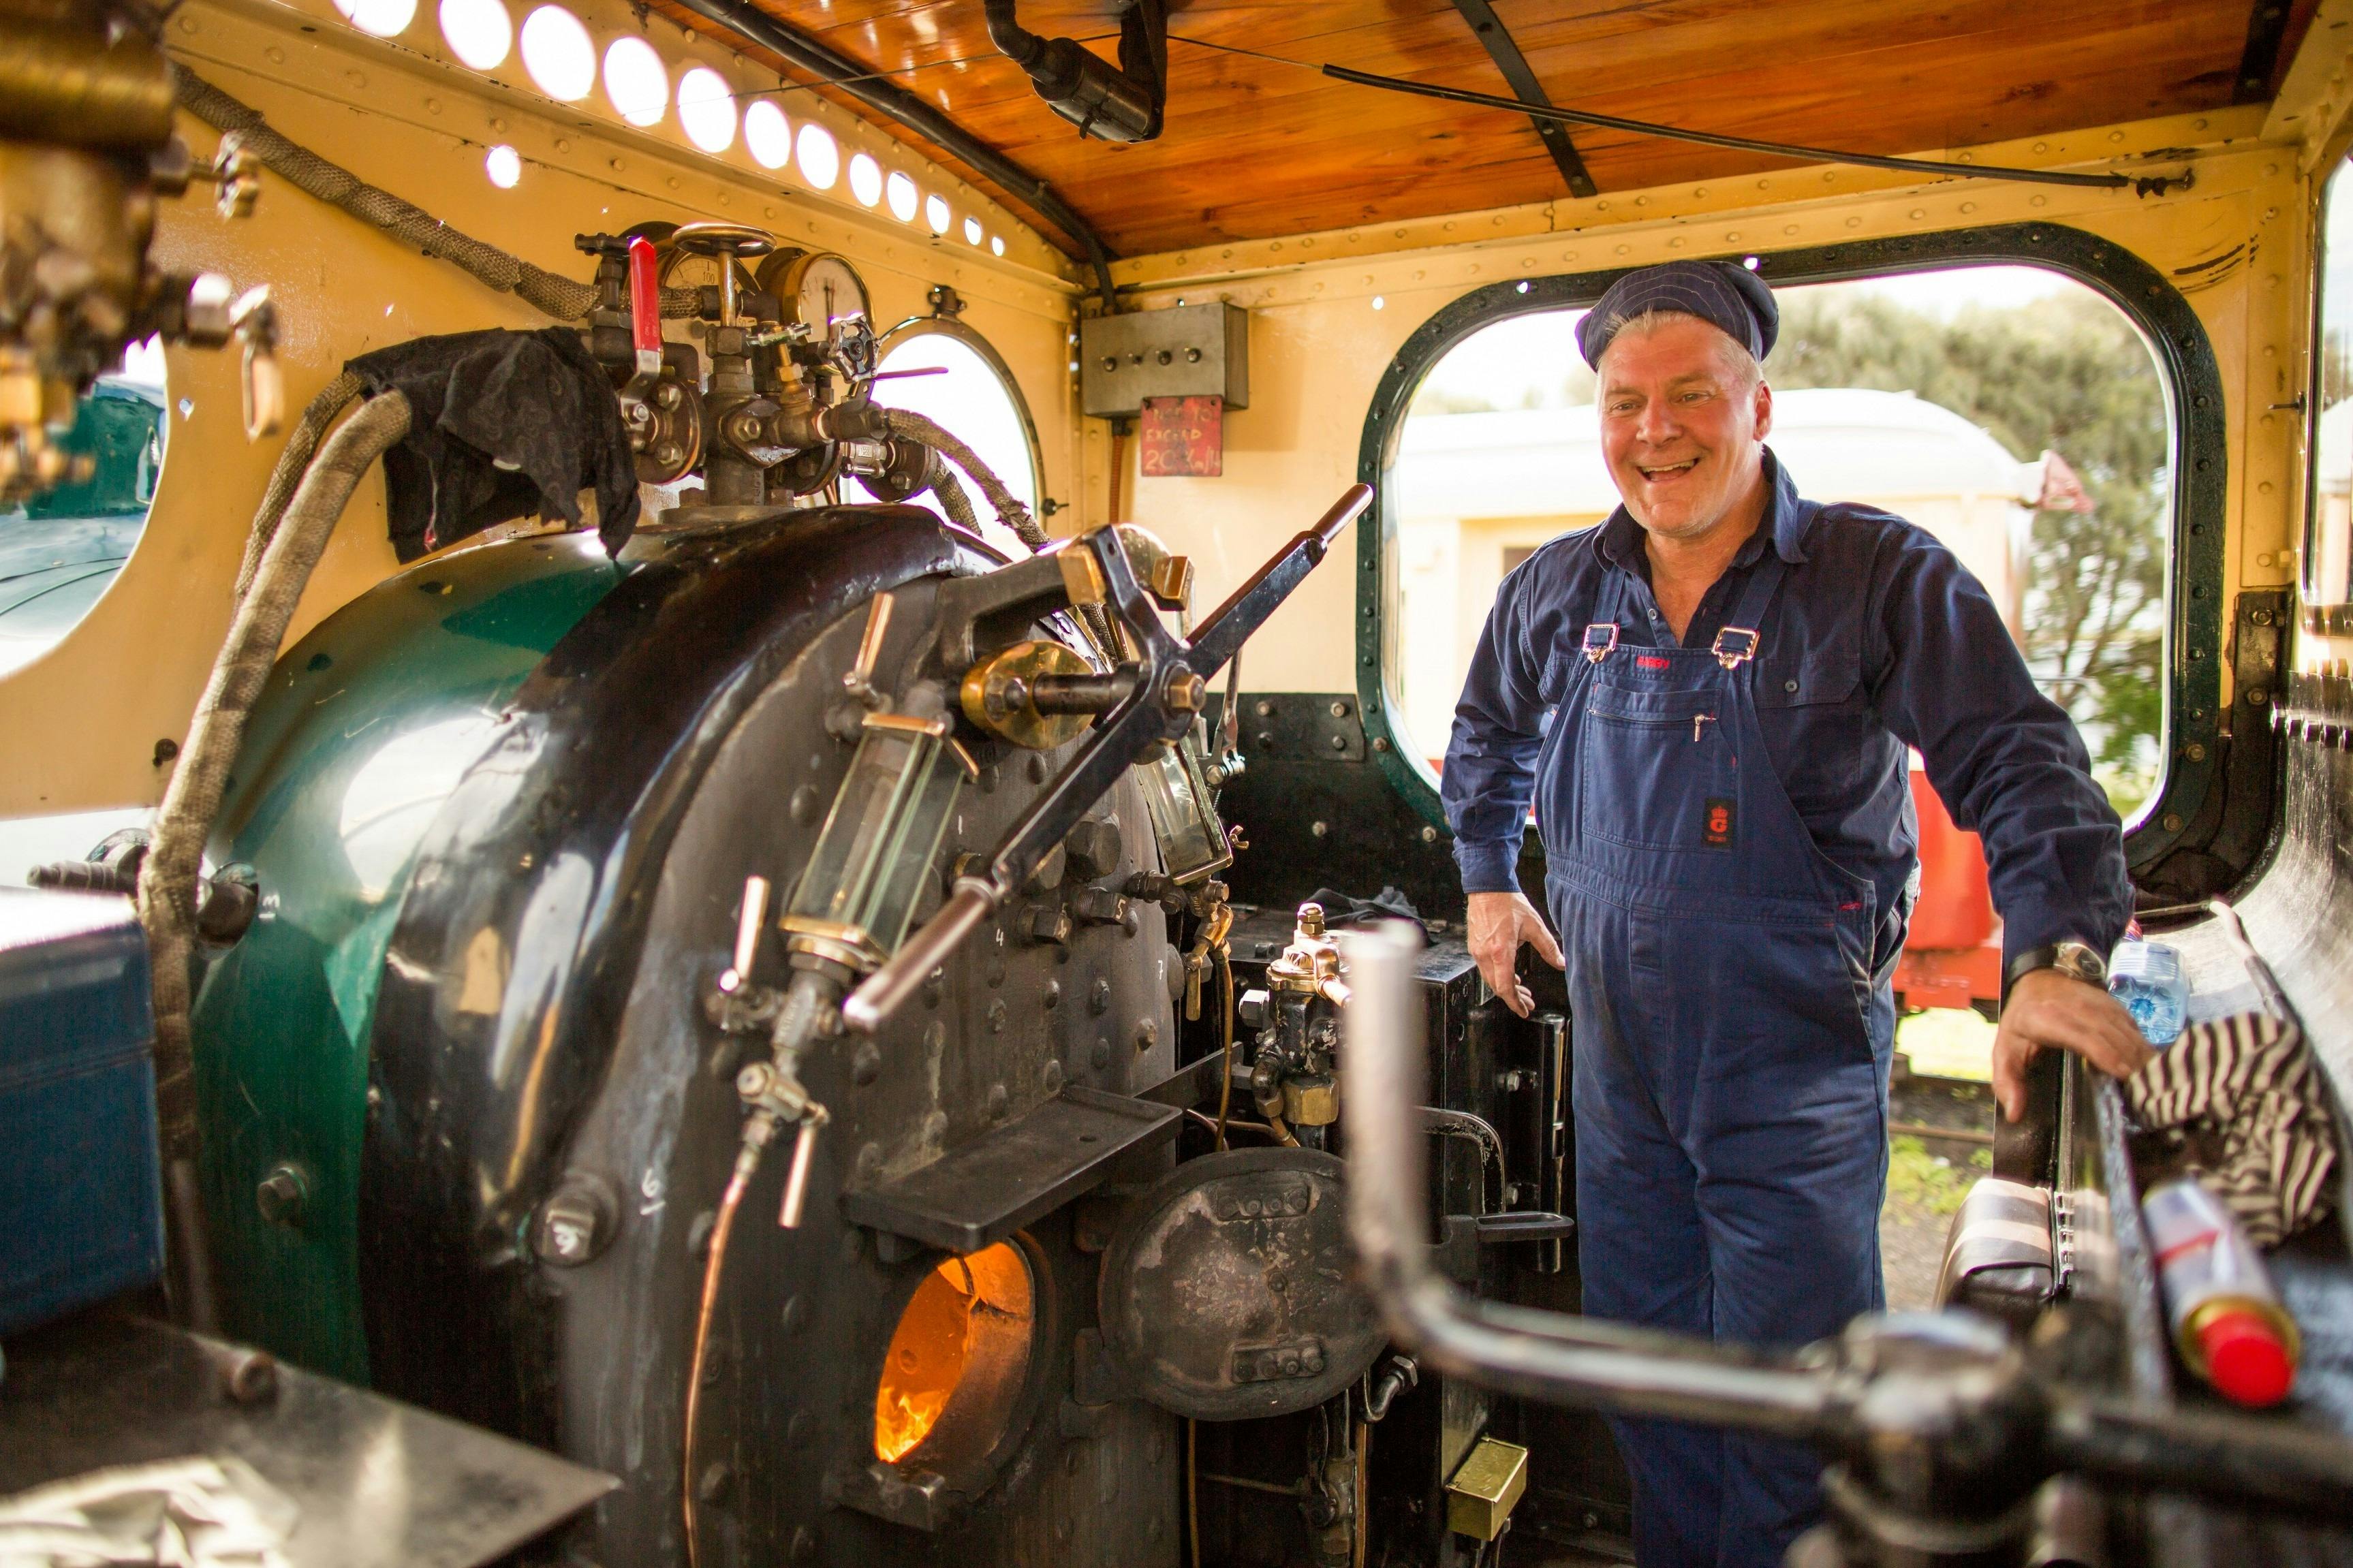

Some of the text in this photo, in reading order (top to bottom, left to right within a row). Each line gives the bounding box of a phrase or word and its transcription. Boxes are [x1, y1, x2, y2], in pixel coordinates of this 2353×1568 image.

[703, 271, 715, 283] 100
[1144, 450, 1176, 471] 20
[1115, 898, 1126, 920] 5
[995, 928, 1004, 947] 4
[1157, 960, 1164, 980] 7
